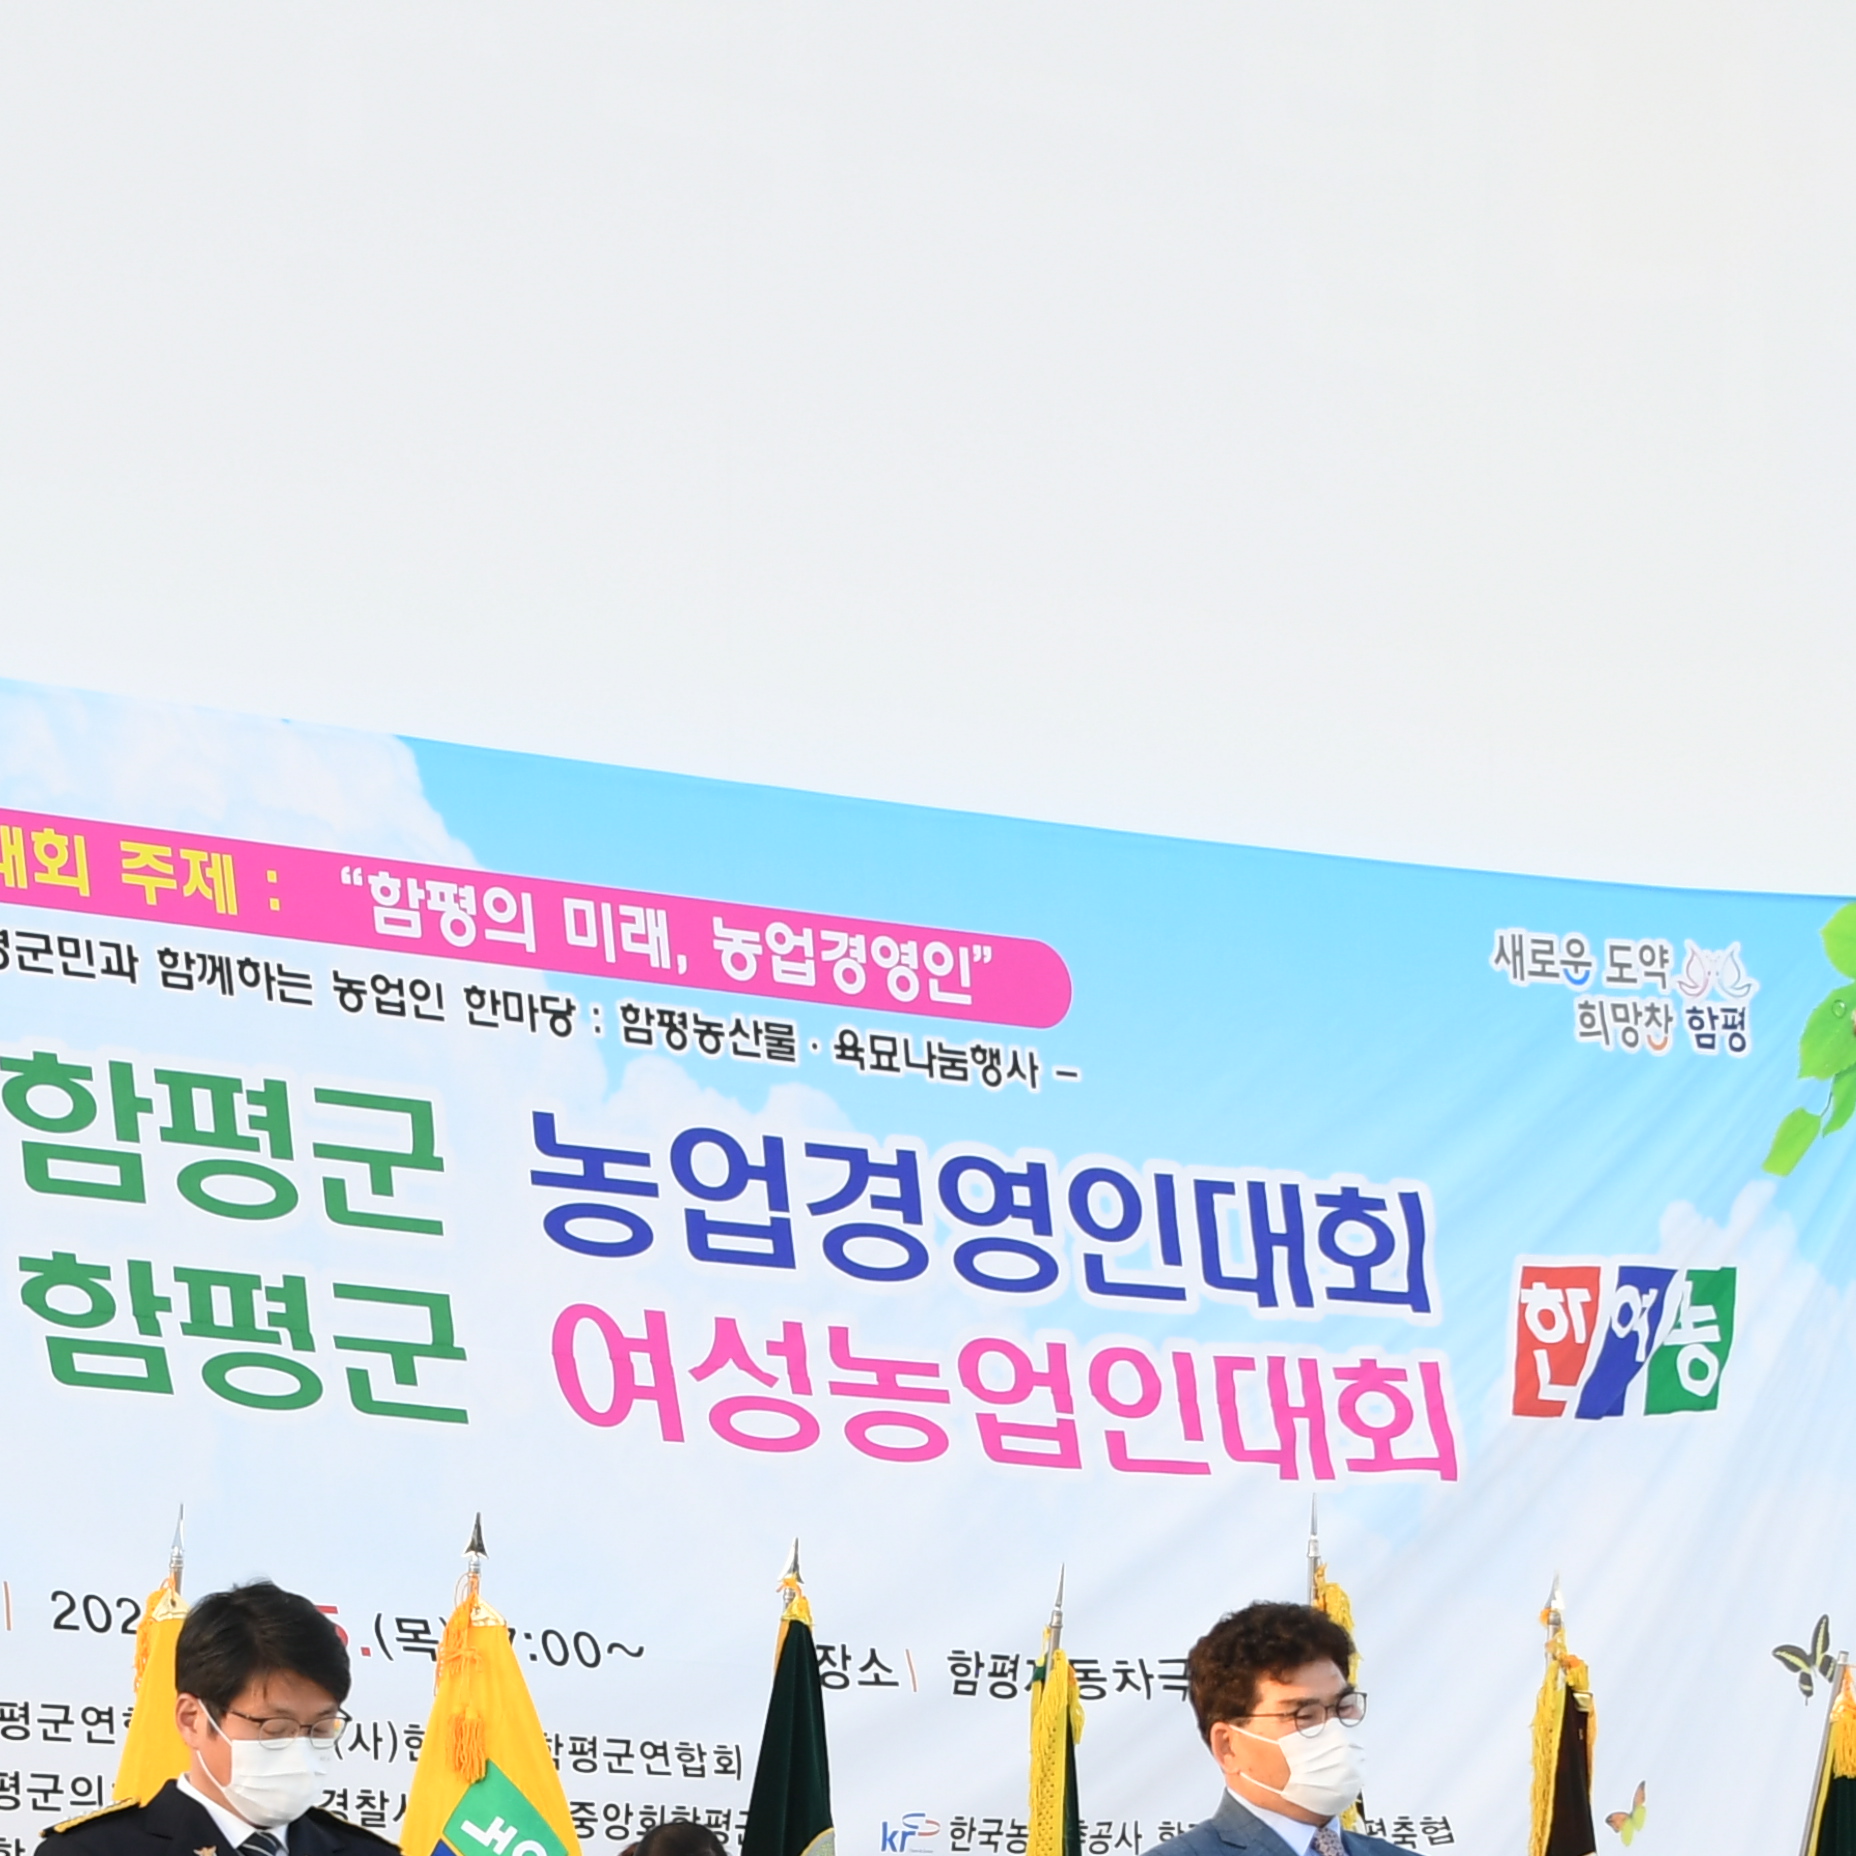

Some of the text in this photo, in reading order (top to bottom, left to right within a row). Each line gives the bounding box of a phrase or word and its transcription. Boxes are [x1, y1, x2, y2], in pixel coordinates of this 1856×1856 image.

[120, 840, 238, 915] 주제
[267, 870, 280, 911] :
[563, 897, 688, 975] 미래,
[1494, 932, 1670, 990] 새로운 도약
[157, 947, 313, 1007] 함께하는
[332, 970, 445, 1023] 농업인
[464, 985, 576, 1038] 한마당
[620, 1003, 796, 1064] 함평농산물
[834, 1029, 1039, 1090] 육묘나눔행사
[1577, 999, 1746, 1053] 희망찬 함평
[530, 1110, 1432, 1314] 농업경영인대회
[18, 1250, 469, 1424] 함평군
[550, 1302, 1460, 1482] 여성농업인대회
[1519, 1278, 1722, 1401] 한여농
[815, 1643, 899, 1690] 장소
[947, 1649, 1189, 1701] 함평동차극
[321, 1788, 406, 1828] 경찰
[950, 1816, 1142, 1856] 한국농공사
